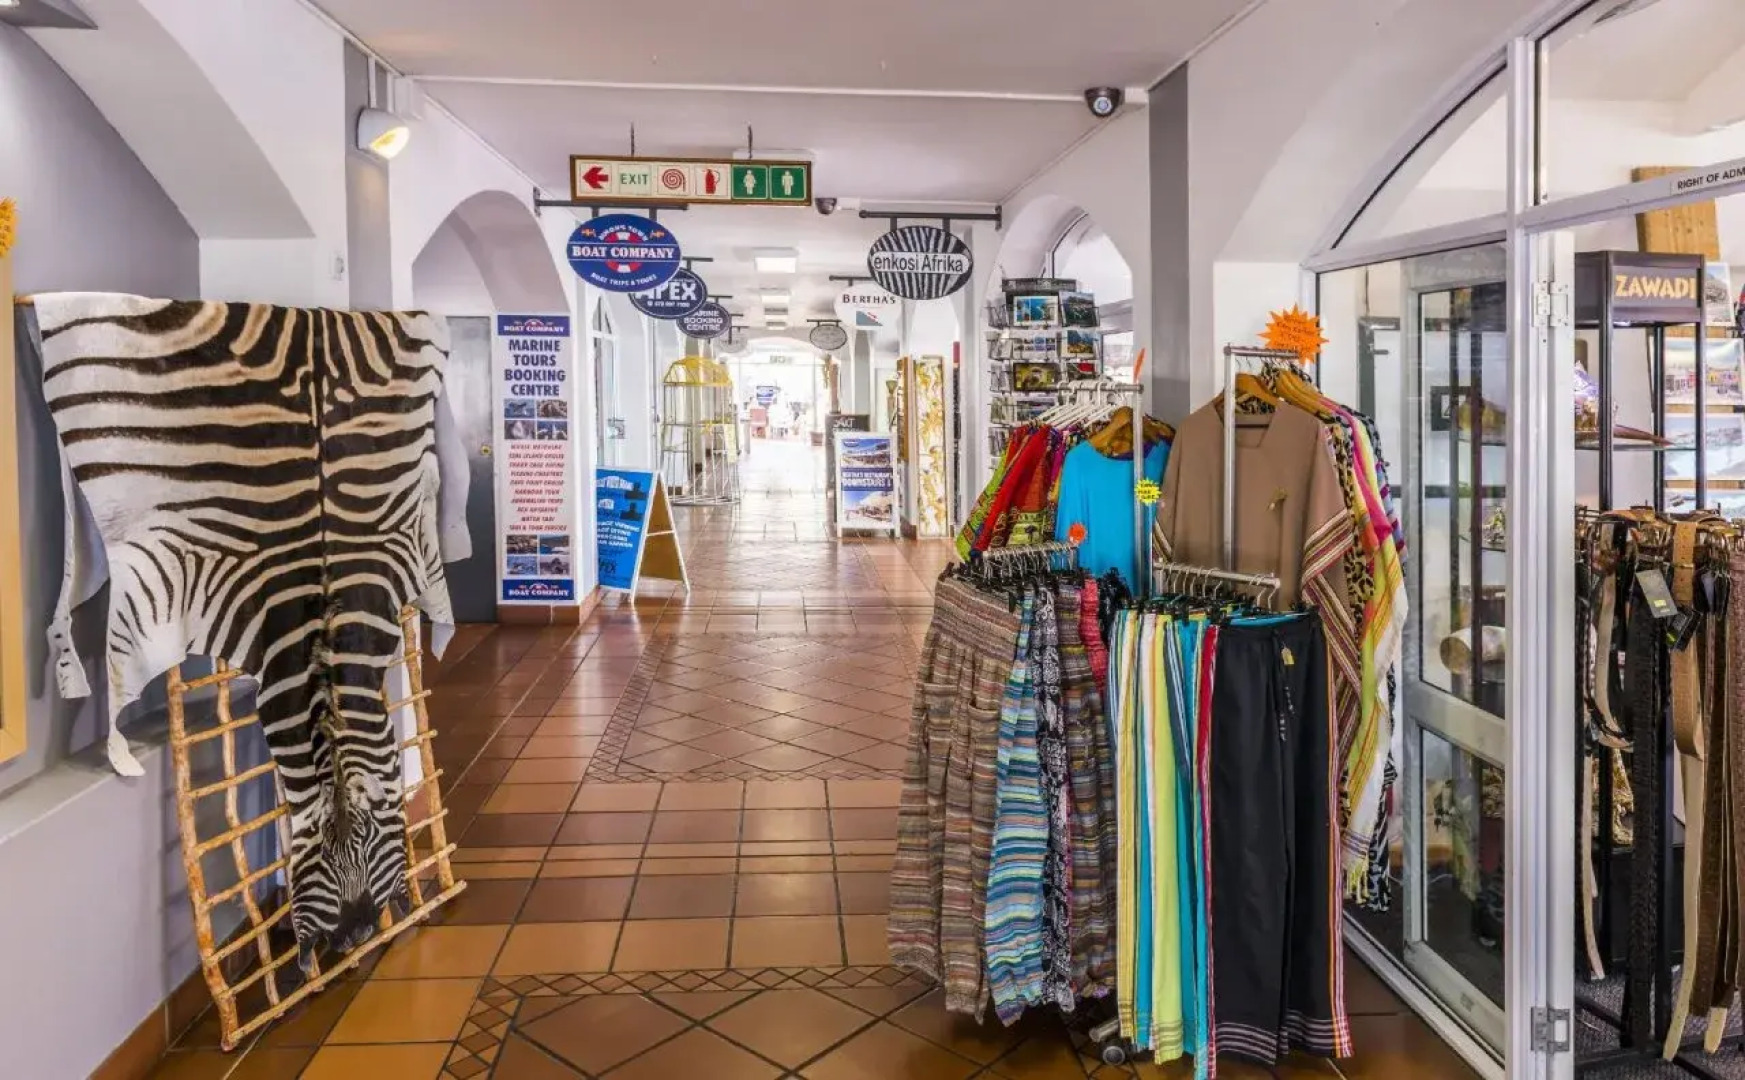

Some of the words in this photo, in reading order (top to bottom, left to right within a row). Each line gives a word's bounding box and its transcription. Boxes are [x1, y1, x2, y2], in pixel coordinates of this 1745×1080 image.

[621, 173, 649, 186] EXIT
[1677, 177, 1704, 190] RIGHT
[1706, 172, 1720, 184] OF
[572, 246, 608, 257] BOAT
[610, 247, 675, 259] COMPANY
[873, 253, 919, 271] enkosi
[921, 254, 963, 272] Afrika
[590, 272, 608, 282] BOAT
[636, 273, 658, 285] TOURS
[1615, 274, 1696, 299] ZAWADI
[842, 293, 896, 305] BERTHA'S
[508, 339, 561, 352] MARINE
[513, 354, 557, 367] TOURS
[504, 369, 566, 381] BOOKING
[511, 384, 560, 396] CENTRE
[508, 588, 530, 596] BOAT
[531, 589, 569, 597] COMPANY
